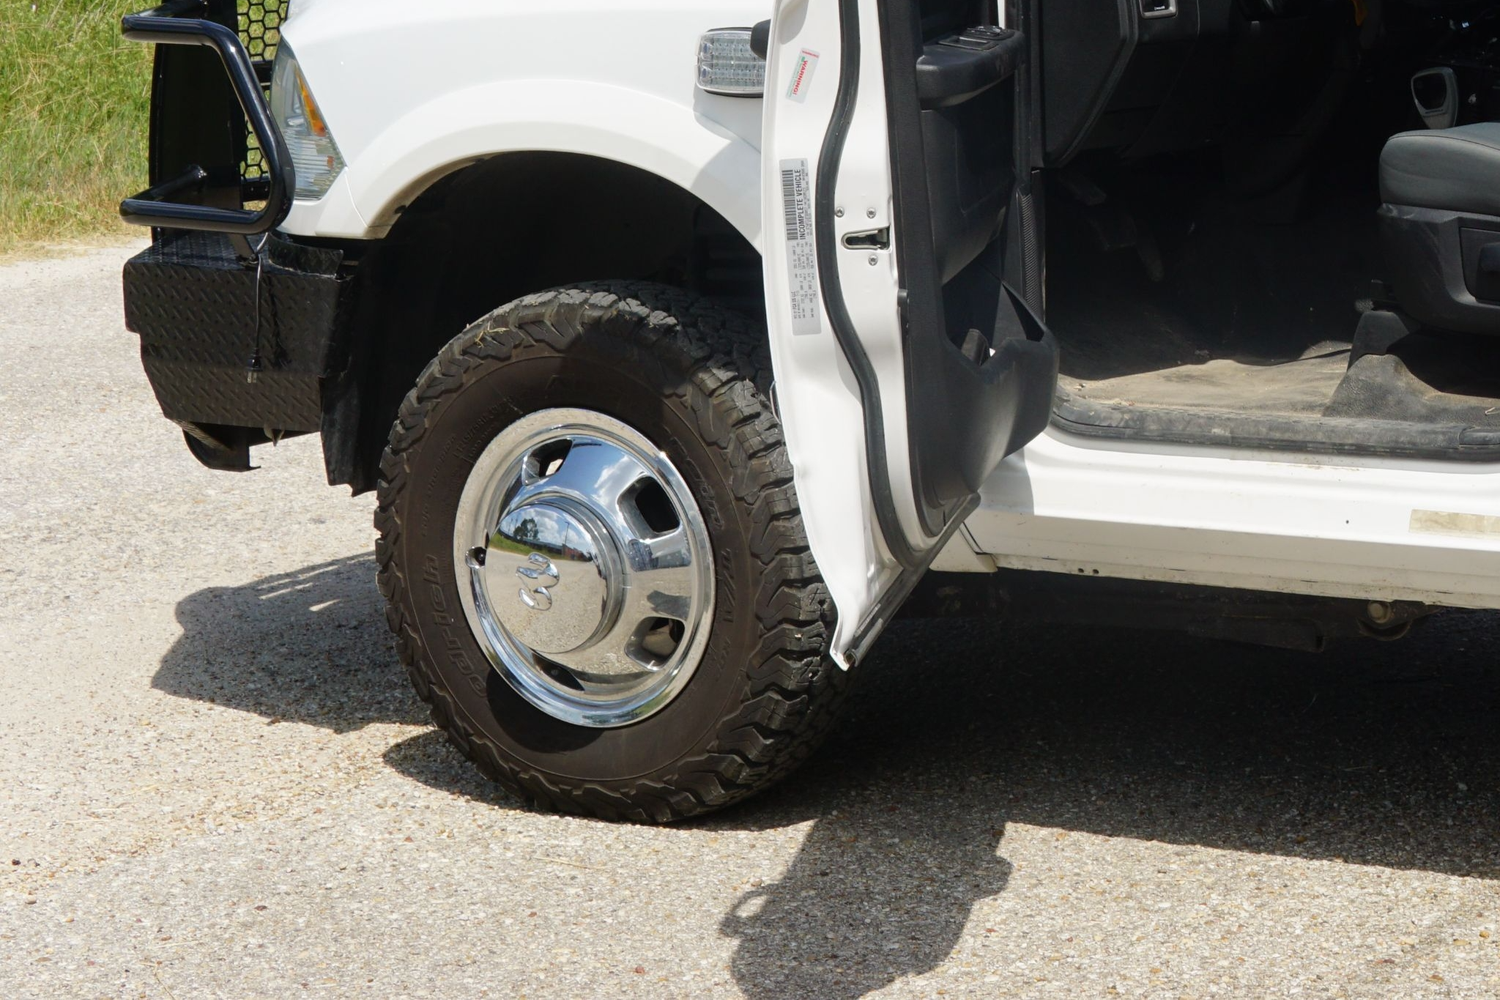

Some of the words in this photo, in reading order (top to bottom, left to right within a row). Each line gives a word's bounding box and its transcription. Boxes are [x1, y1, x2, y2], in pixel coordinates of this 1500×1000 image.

[793, 60, 808, 95] WARNING!
[794, 169, 803, 196] VEHICLE
[797, 199, 806, 240] INCOMPLETE
